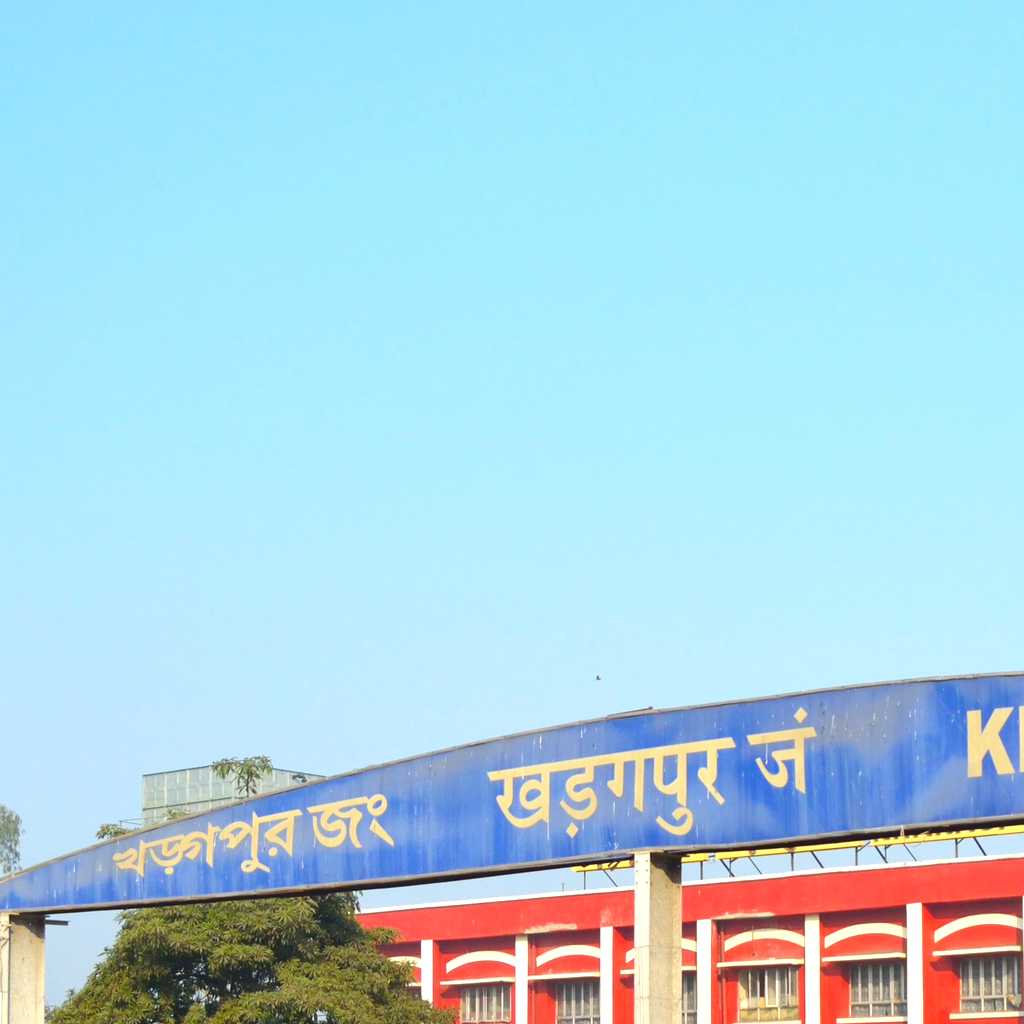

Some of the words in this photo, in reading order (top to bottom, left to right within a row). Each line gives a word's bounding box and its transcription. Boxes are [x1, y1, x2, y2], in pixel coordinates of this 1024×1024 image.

[486, 736, 736, 839] खड़गपुर
[746, 706, 817, 795] जं
[305, 793, 395, 849] জং
